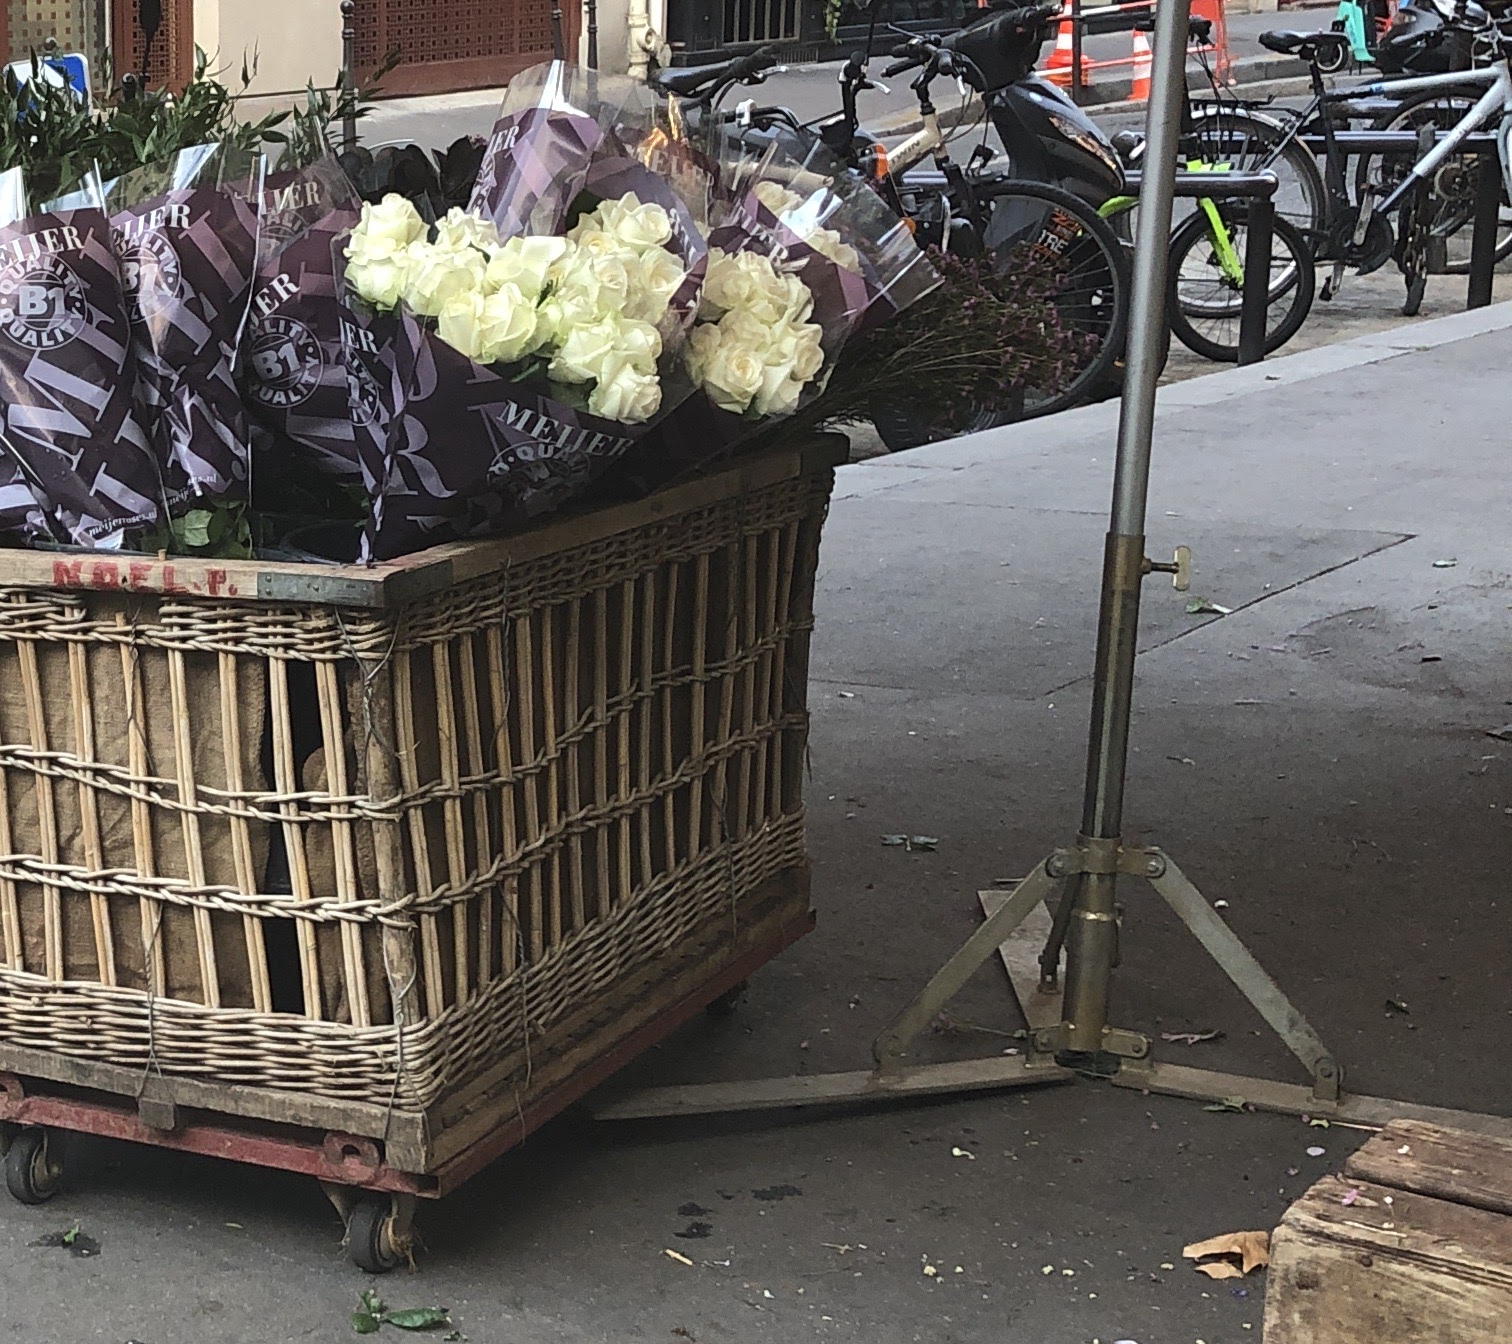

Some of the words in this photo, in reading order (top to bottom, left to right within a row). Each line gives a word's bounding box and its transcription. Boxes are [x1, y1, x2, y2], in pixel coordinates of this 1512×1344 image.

[18, 285, 66, 316] B1
[252, 342, 302, 380] B1
[496, 399, 636, 457] MEIJER
